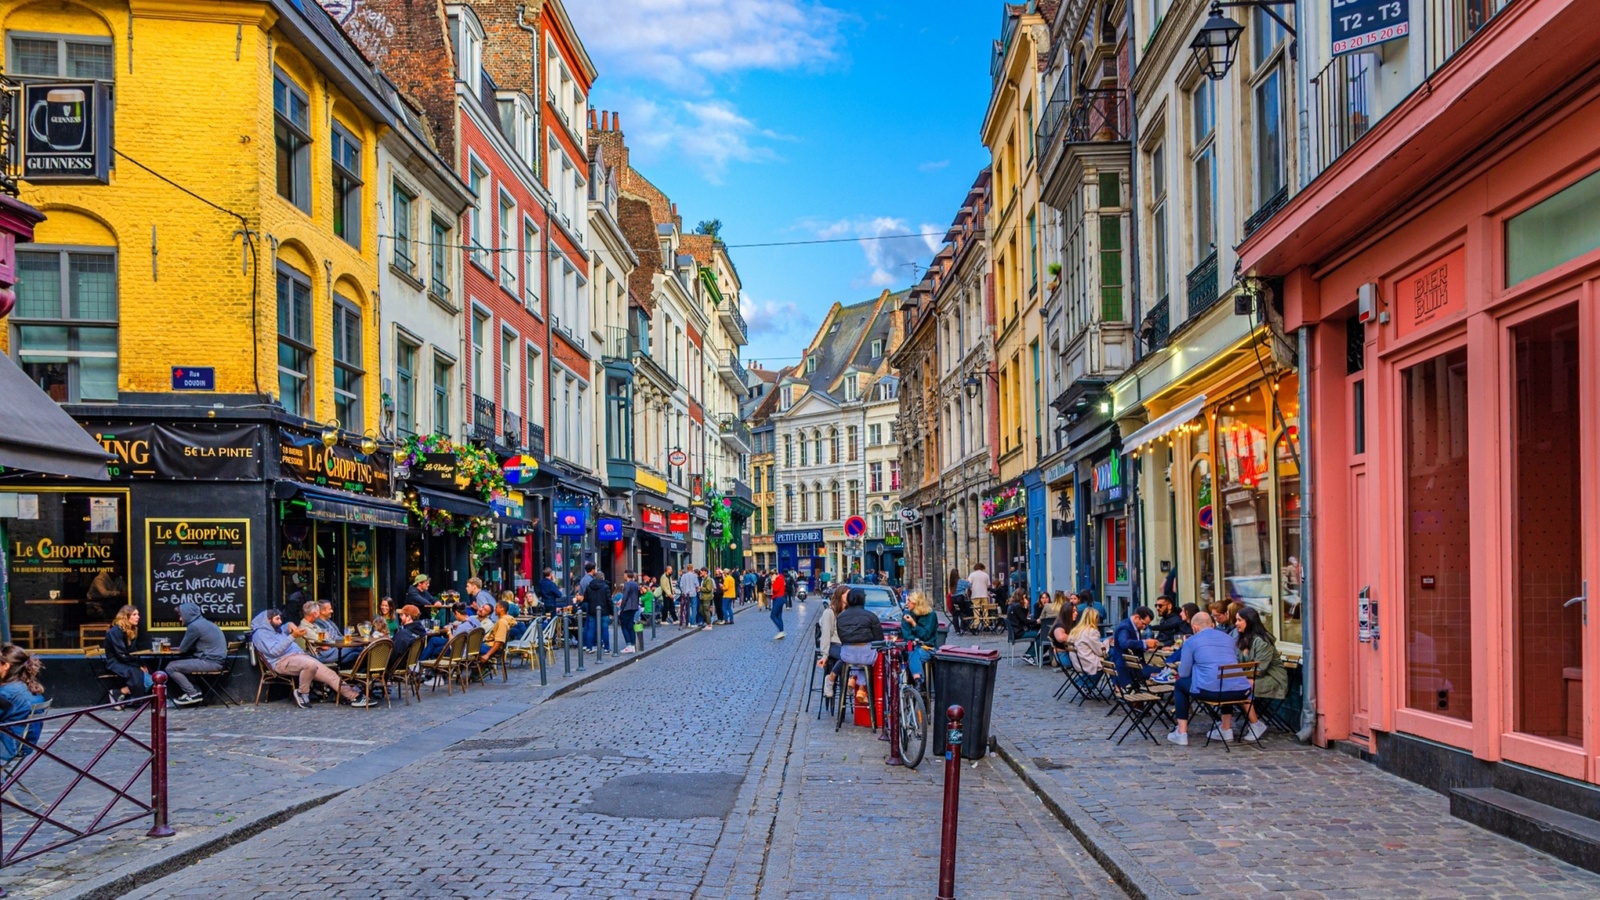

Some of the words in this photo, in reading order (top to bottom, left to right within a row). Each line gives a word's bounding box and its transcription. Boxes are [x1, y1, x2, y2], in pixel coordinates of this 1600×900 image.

[1340, 13, 1362, 31] T2
[1378, 2, 1401, 20] T3
[1334, 42, 1346, 52] 03
[1350, 37, 1363, 48] 20
[1366, 32, 1376, 43] 15
[1380, 28, 1393, 40] 20
[1396, 24, 1408, 34] 61
[27, 157, 92, 170] GUINNESS
[184, 446, 198, 456] 5€
[200, 447, 216, 456] LA
[218, 448, 253, 458] PINTE
[308, 444, 322, 472] Le
[156, 526, 172, 540] Le
[886, 521, 900, 532] PIZZA
[794, 532, 818, 540] FERMIER
[16, 542, 33, 557] Le
[170, 592, 236, 604] BARBECUE
[200, 604, 244, 614] FFERT
